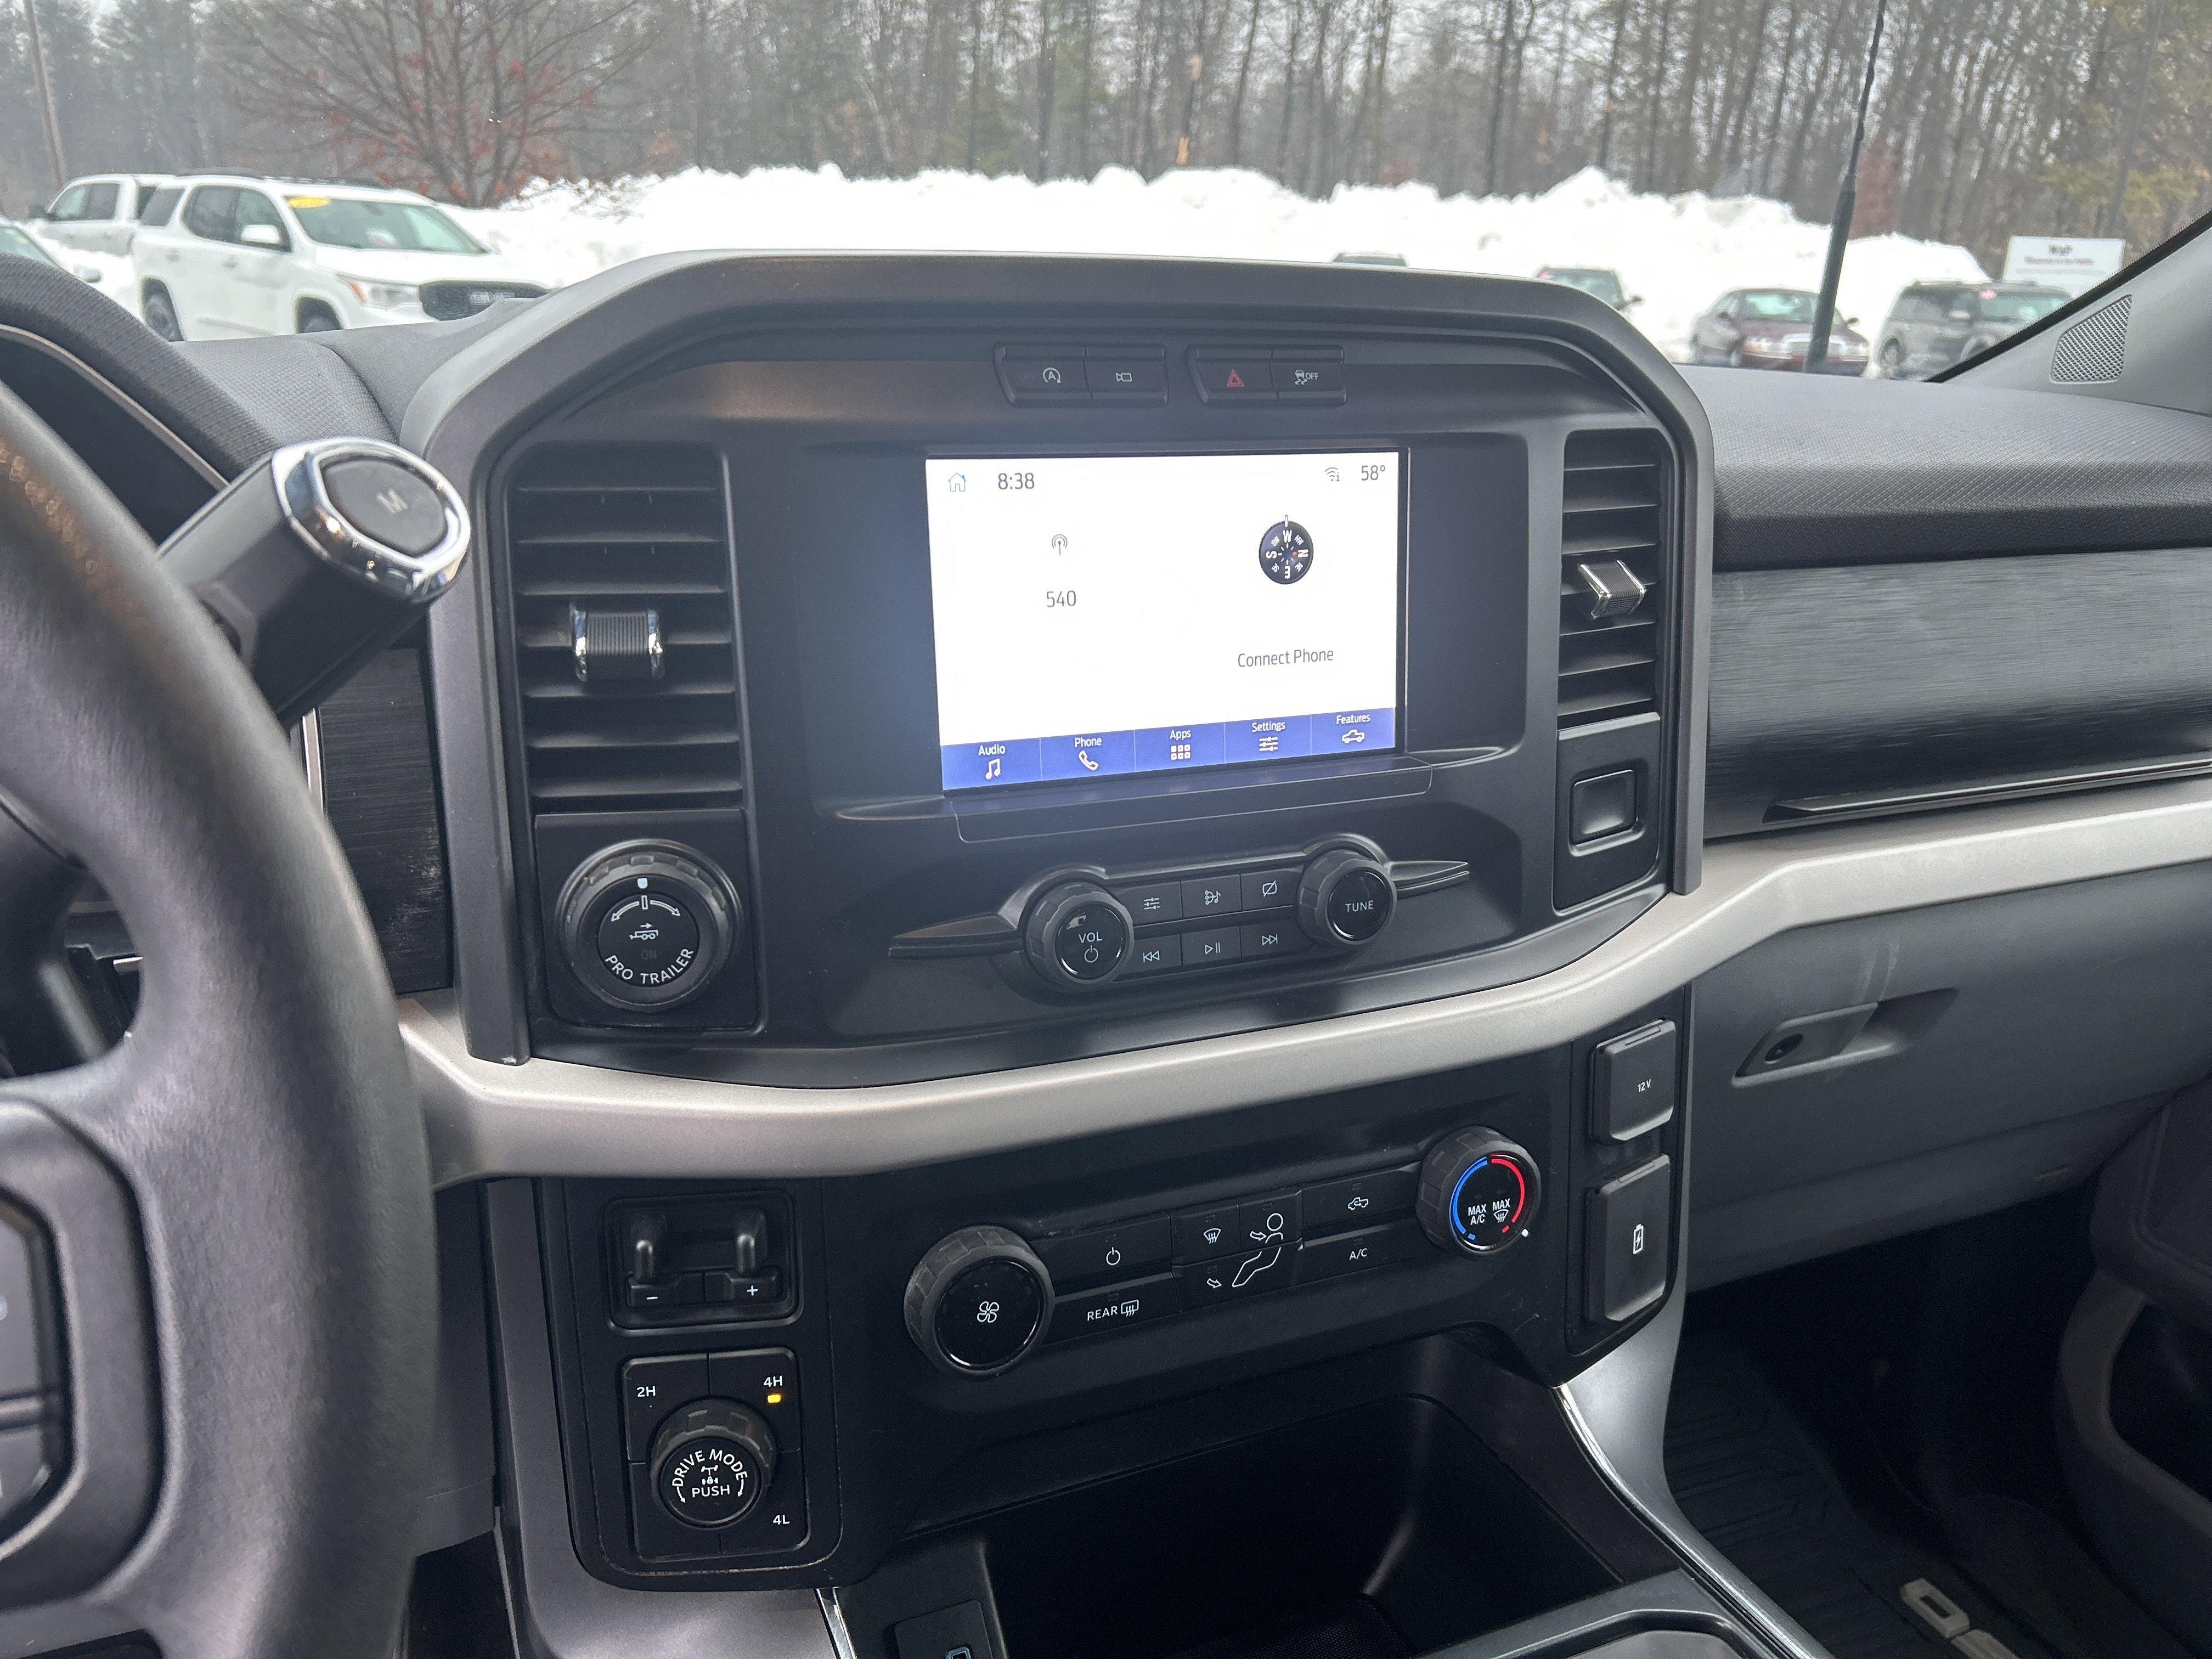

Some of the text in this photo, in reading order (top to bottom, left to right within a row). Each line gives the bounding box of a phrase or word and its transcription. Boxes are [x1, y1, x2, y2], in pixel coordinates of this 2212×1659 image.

[1361, 465, 1386, 481] 58°
[998, 472, 1035, 490] 8:38
[1283, 529, 1292, 543] W
[1297, 549, 1309, 557] N
[1284, 566, 1290, 579] E
[1046, 590, 1077, 608] 540
[1237, 648, 1334, 668] Connect Phone
[1336, 712, 1371, 725] Features
[1251, 719, 1286, 733] Settings
[1074, 736, 1103, 748] Phone
[1170, 729, 1192, 742] Apps
[978, 744, 1006, 756] Audio
[1345, 900, 1374, 912] TUNE
[1078, 932, 1103, 943] VOL
[605, 948, 694, 985] PRO TRAILER
[1468, 1204, 1486, 1216] MAX
[1492, 1198, 1510, 1211] MAX
[1470, 1214, 1485, 1225] A/C
[1349, 1247, 1368, 1261] A/C
[1087, 1305, 1118, 1322] REAR
[763, 1375, 783, 1387] 4H
[636, 1386, 656, 1397] 2H
[672, 1448, 748, 1488] DRIVE MODE
[691, 1484, 731, 1498] PUSH
[772, 1514, 790, 1525] 4L
